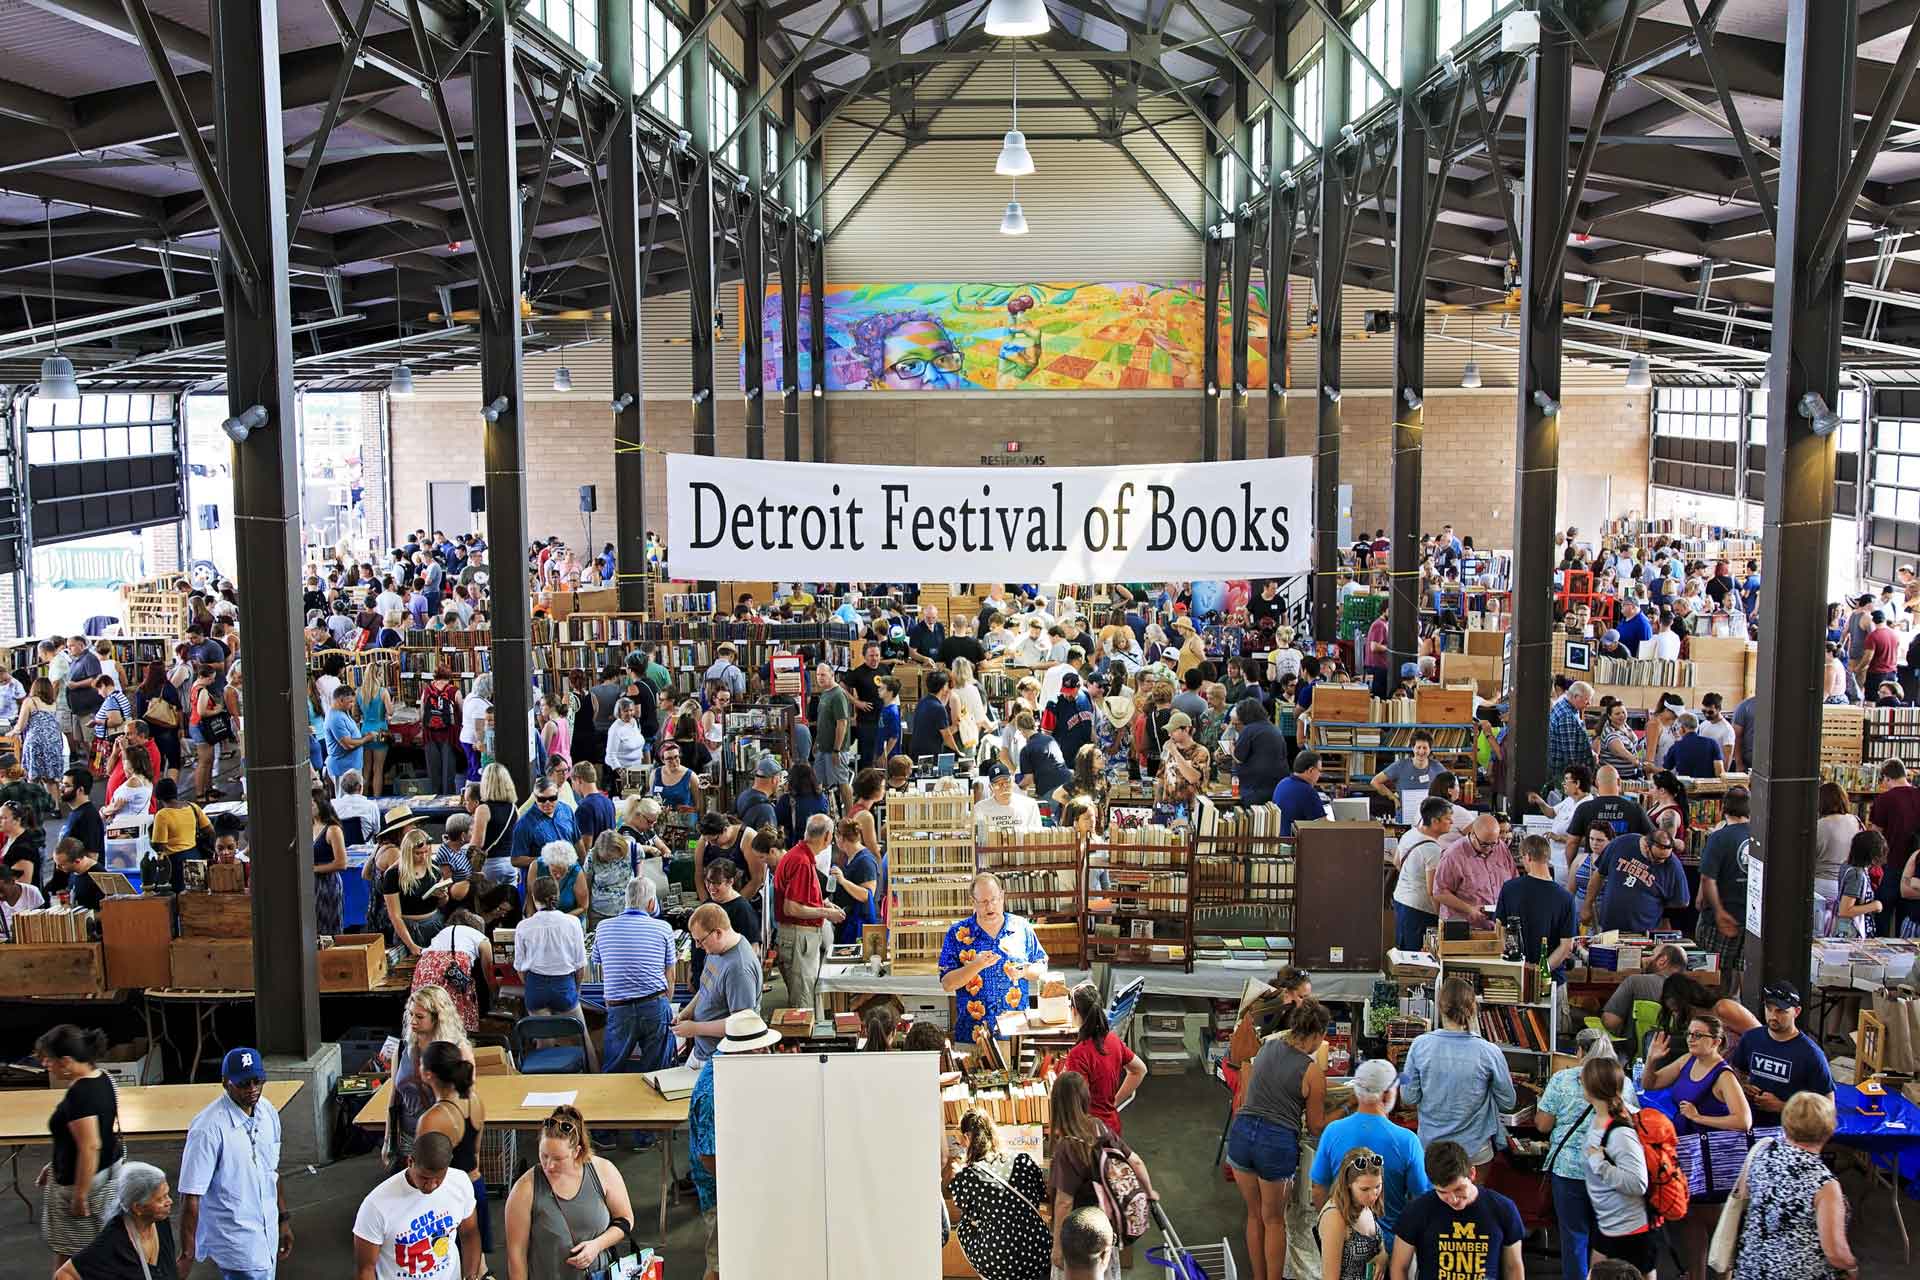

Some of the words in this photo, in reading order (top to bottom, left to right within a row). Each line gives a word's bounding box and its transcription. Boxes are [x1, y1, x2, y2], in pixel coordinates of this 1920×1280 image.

[689, 482, 865, 551] Detroit
[880, 482, 1067, 553] Festival
[1083, 482, 1135, 553] of
[1146, 481, 1290, 553] Books
[1604, 803, 1618, 811] WE
[1615, 857, 1656, 888] TIGERS
[1755, 1056, 1787, 1076] YETI
[410, 1210, 436, 1231] GUS
[1452, 1221, 1476, 1240] M
[1438, 1240, 1489, 1252] NUMBER
[1438, 1251, 1487, 1274] ONE
